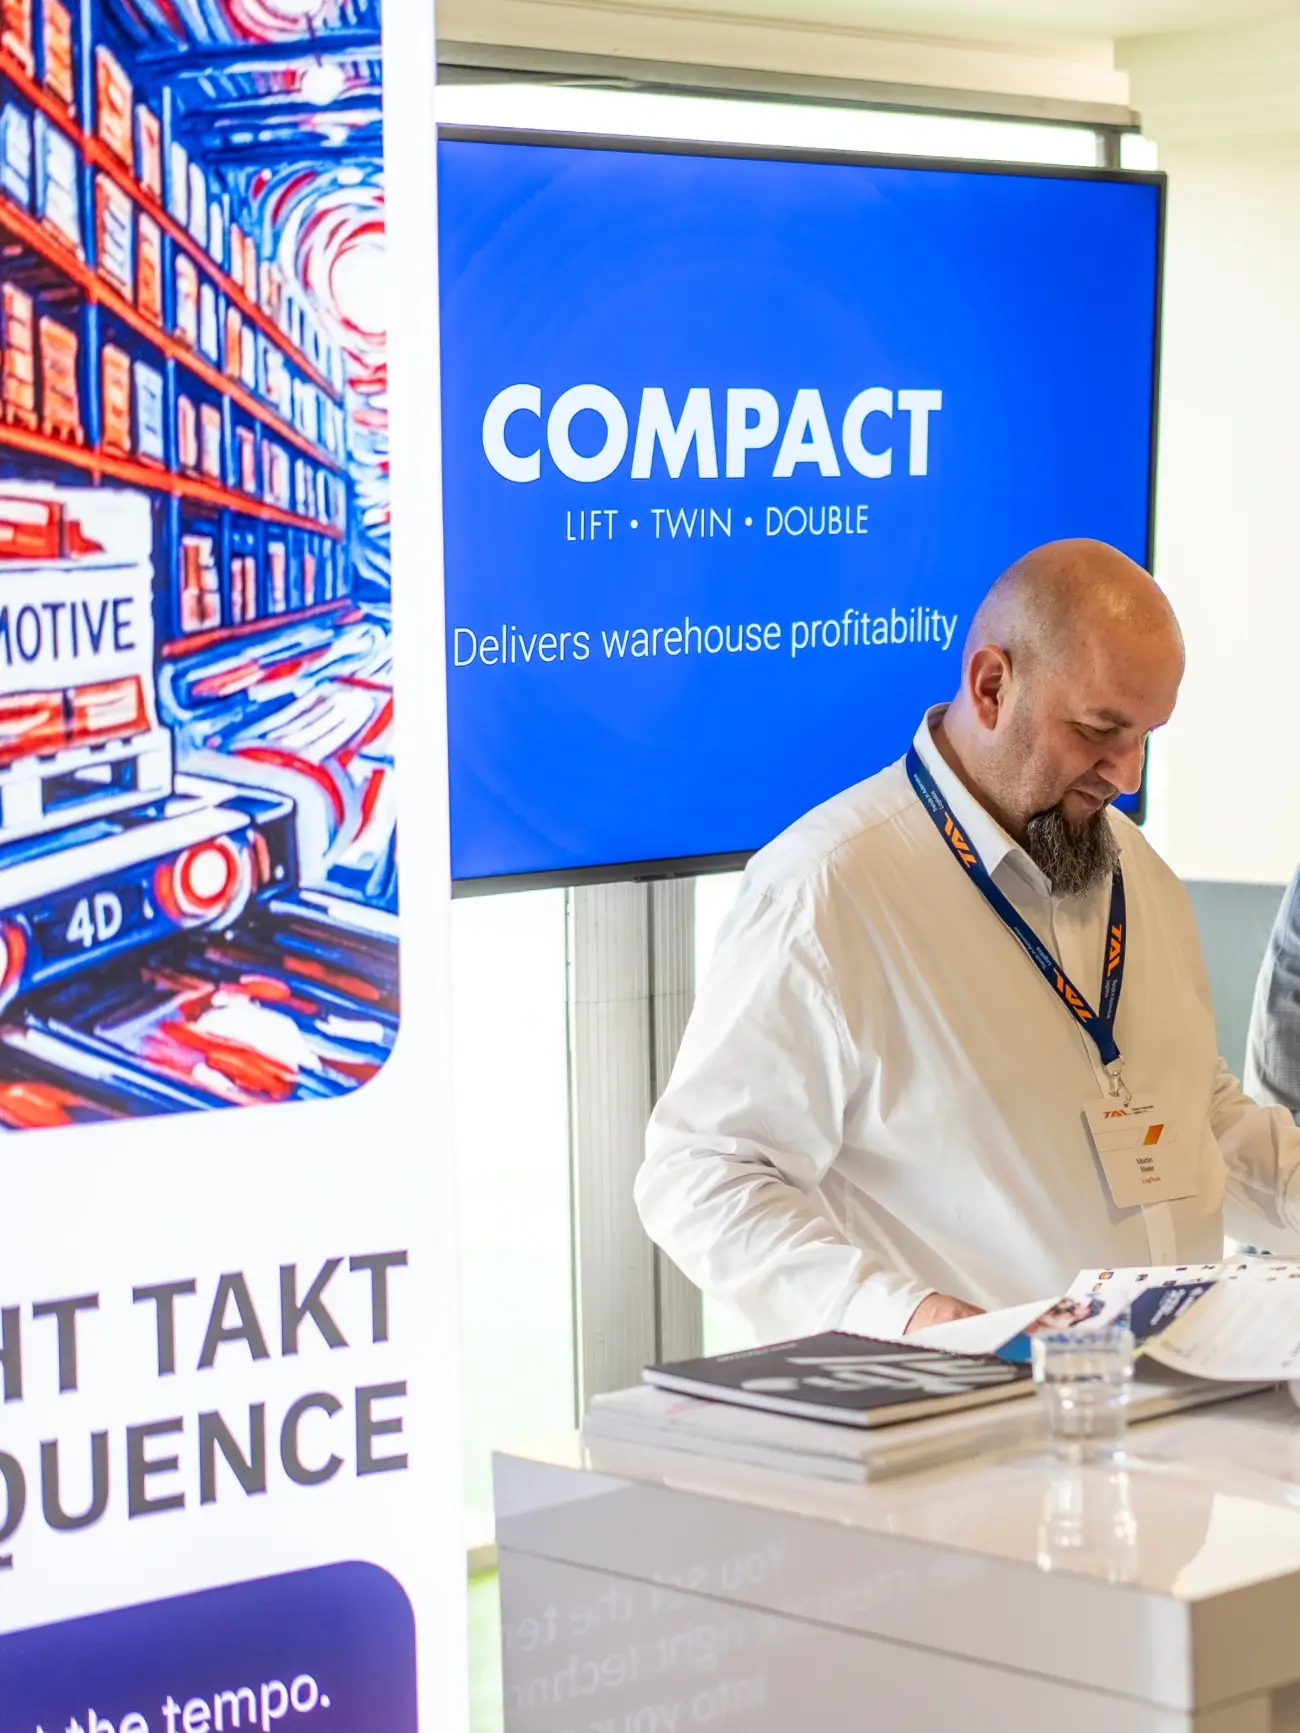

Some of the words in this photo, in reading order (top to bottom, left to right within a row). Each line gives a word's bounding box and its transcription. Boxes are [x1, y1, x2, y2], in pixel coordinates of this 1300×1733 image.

[482, 383, 943, 482] COMPACT
[566, 509, 619, 541] LIFT
[650, 507, 732, 539] TWIN
[766, 504, 869, 537] DOUBLE
[453, 624, 591, 667] Delivers
[601, 616, 782, 661] warehouse
[791, 606, 959, 656] profitability
[944, 811, 977, 868] TAL
[65, 891, 124, 949] 4D
[1107, 923, 1122, 977] TAL
[1053, 967, 1093, 1023] TAL
[132, 1249, 410, 1378] TAKT
[162, 1673, 331, 1733] tempo.
